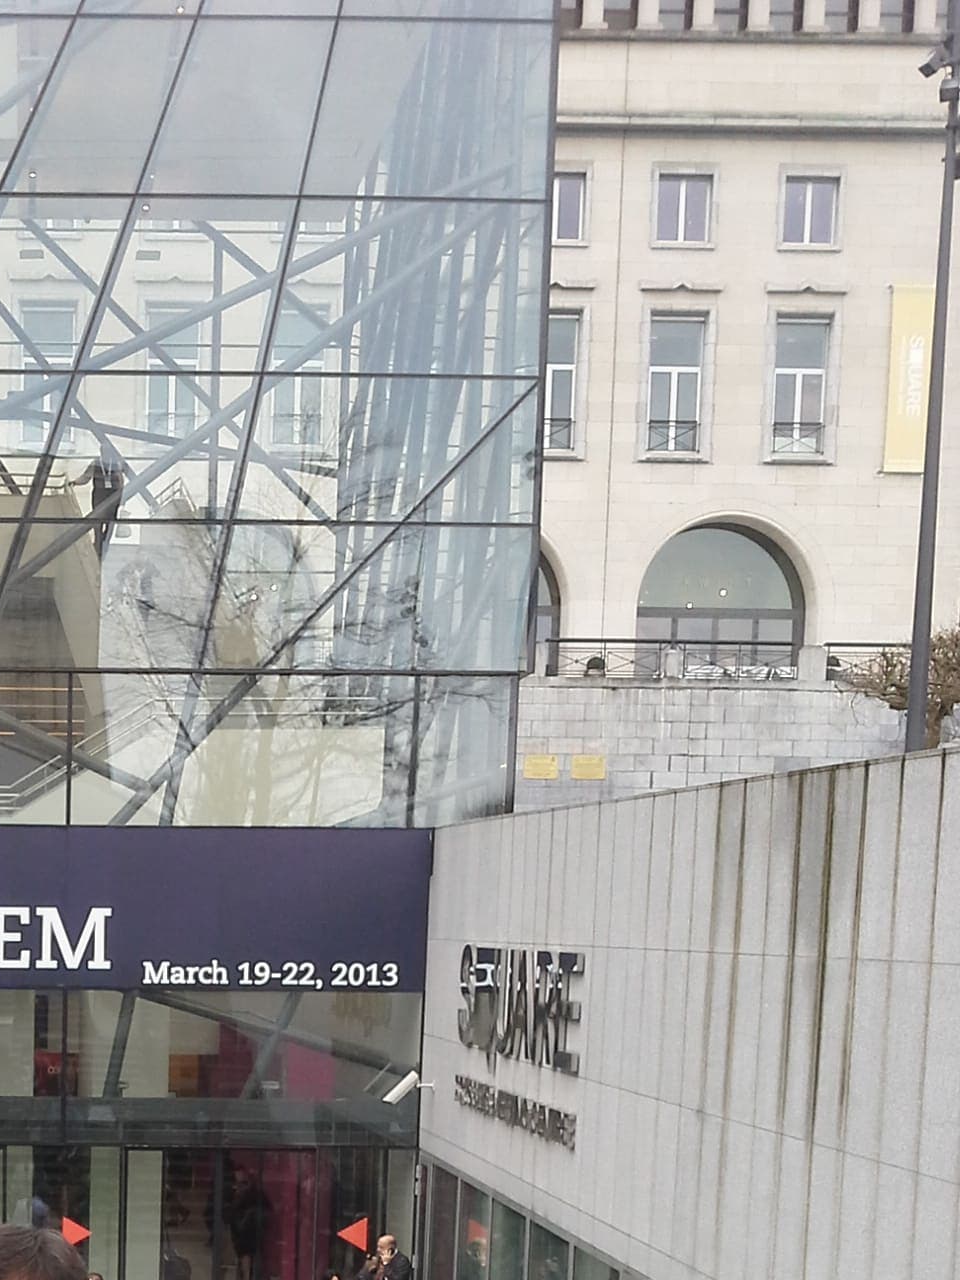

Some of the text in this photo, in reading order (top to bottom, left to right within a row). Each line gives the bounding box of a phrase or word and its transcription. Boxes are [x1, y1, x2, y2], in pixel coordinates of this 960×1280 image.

[142, 959, 398, 990] March 19-22, 2013
